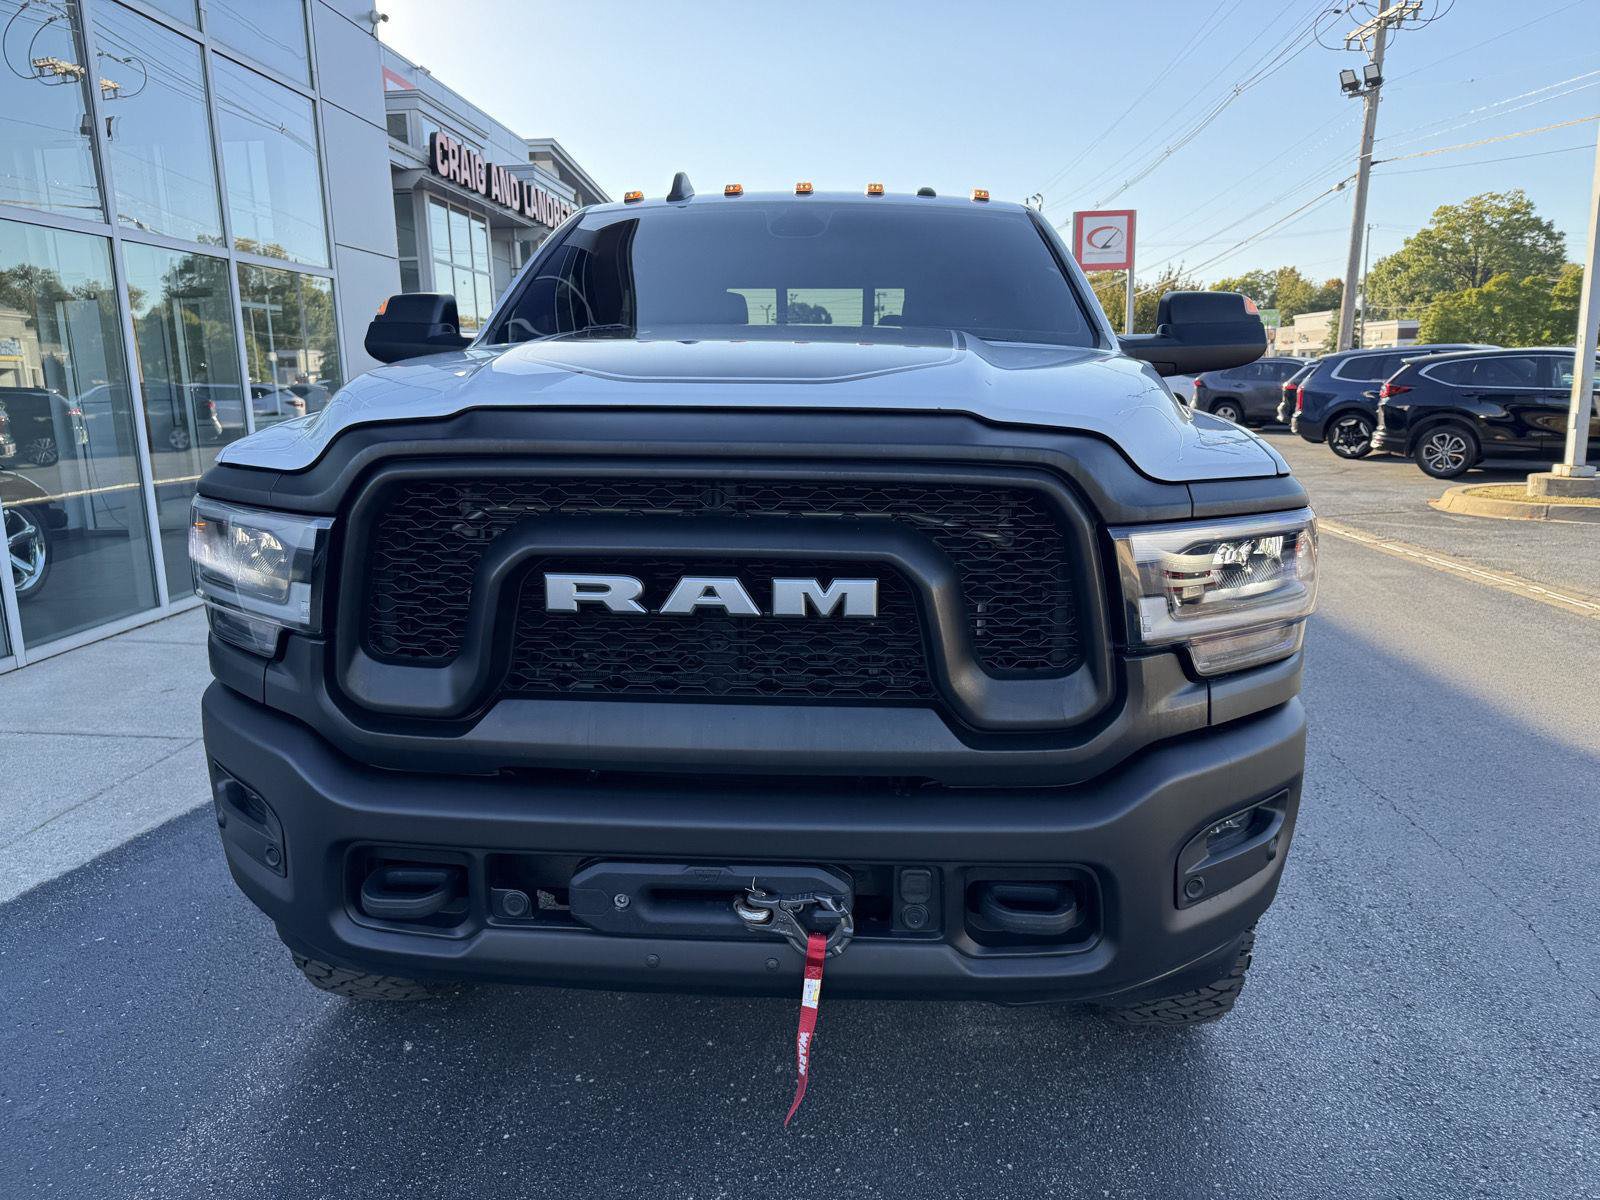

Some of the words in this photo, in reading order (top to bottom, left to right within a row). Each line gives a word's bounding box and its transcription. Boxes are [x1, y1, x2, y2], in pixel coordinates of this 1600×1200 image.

[435, 131, 487, 195] CRAIG
[491, 162, 520, 211] AND
[544, 572, 879, 617] RAM
